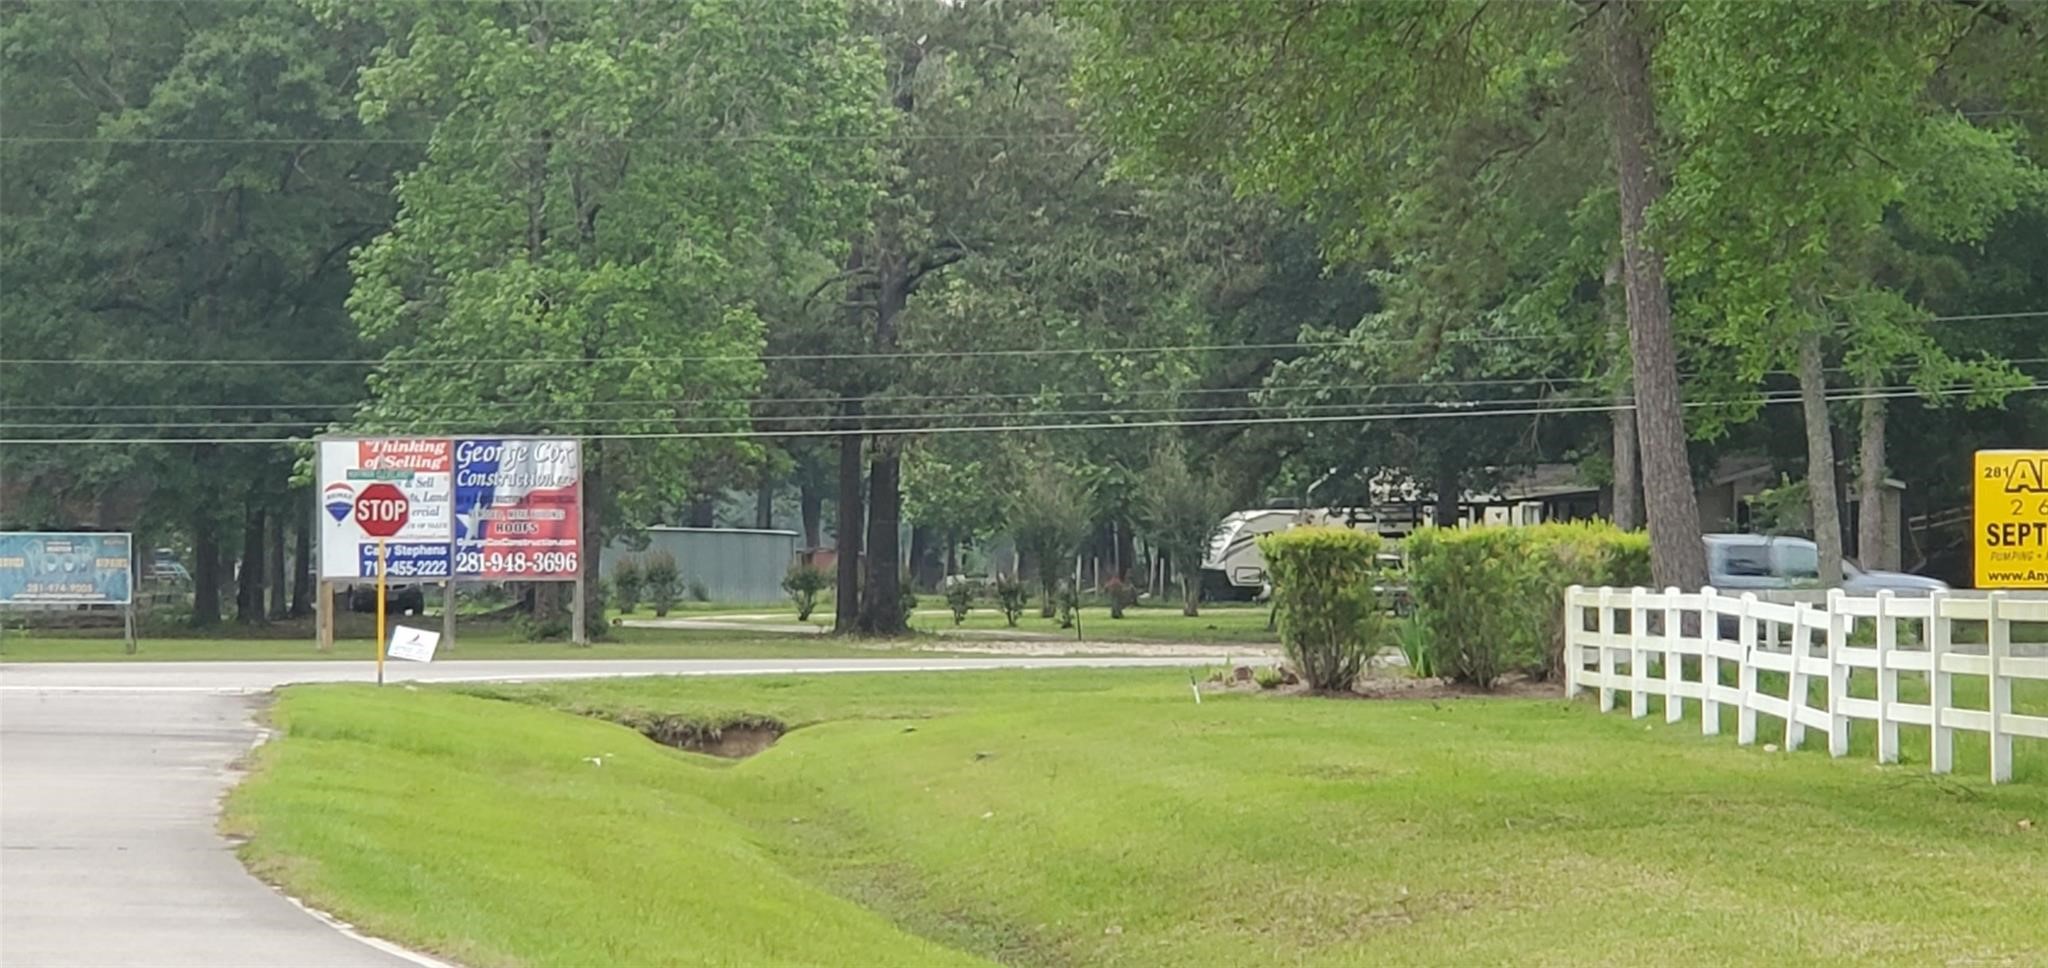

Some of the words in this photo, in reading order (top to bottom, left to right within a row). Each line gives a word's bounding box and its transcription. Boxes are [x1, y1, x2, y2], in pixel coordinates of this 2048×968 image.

[364, 455, 380, 470] of
[456, 441, 529, 472] George
[533, 442, 577, 469] Cox
[1984, 466, 2009, 479] 281
[423, 491, 449, 502] Land
[357, 499, 407, 521] STOP
[1986, 522, 2047, 547] SEPT
[364, 545, 391, 558] Cay
[393, 545, 447, 558] Stephens
[364, 561, 447, 576] 71-455-2222
[456, 552, 578, 572] 281-948-3696
